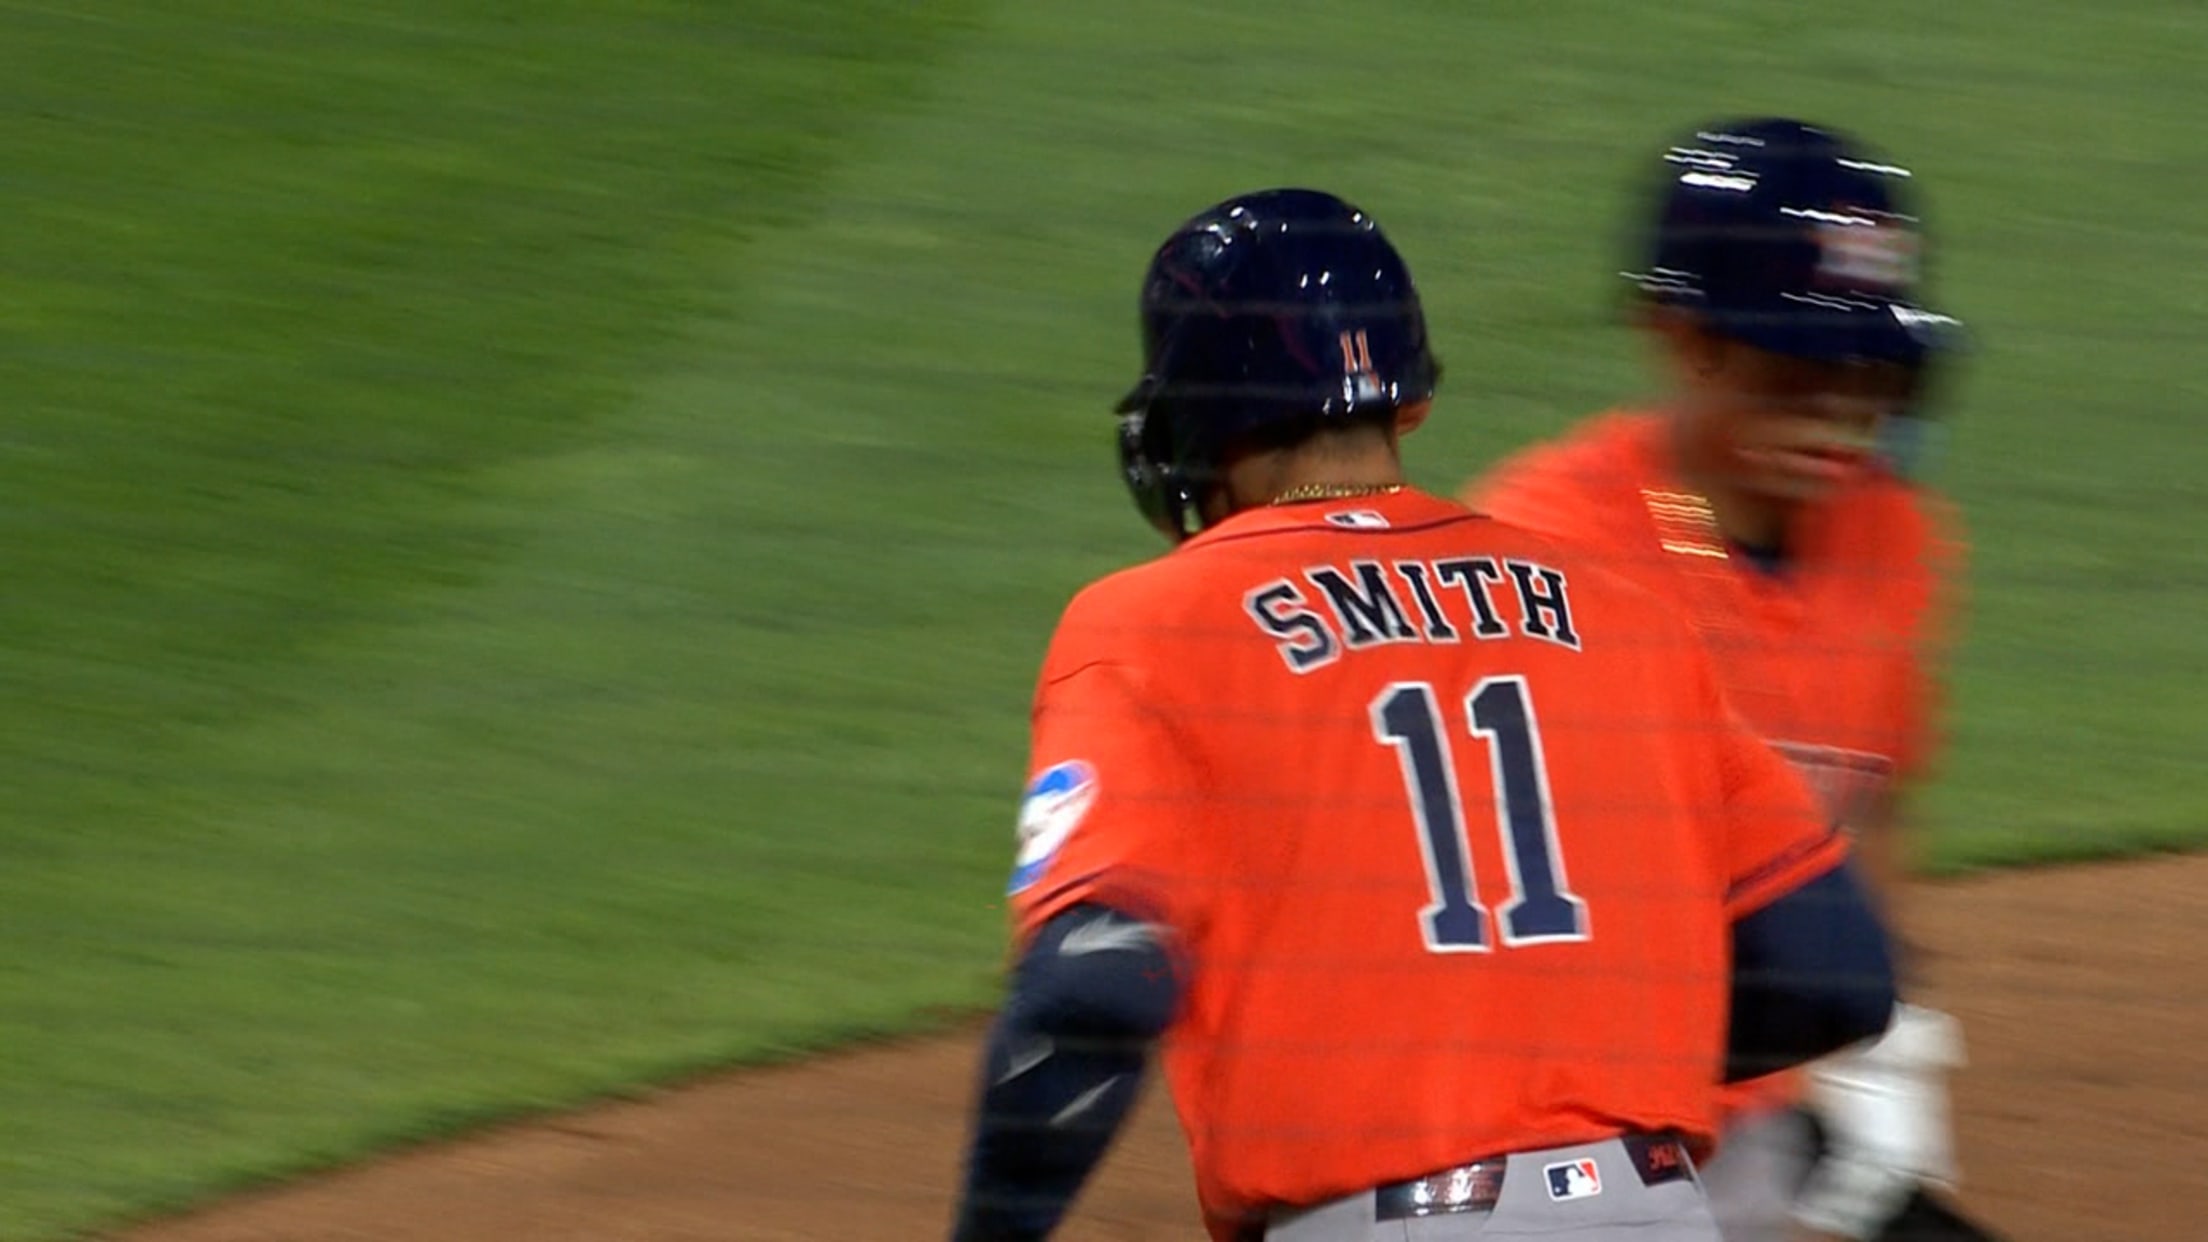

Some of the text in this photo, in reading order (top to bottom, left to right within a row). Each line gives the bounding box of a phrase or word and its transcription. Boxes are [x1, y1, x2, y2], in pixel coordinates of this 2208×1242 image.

[1340, 328, 1372, 373] 11
[1243, 556, 1582, 674] SMITH
[1367, 674, 1593, 954] 11
